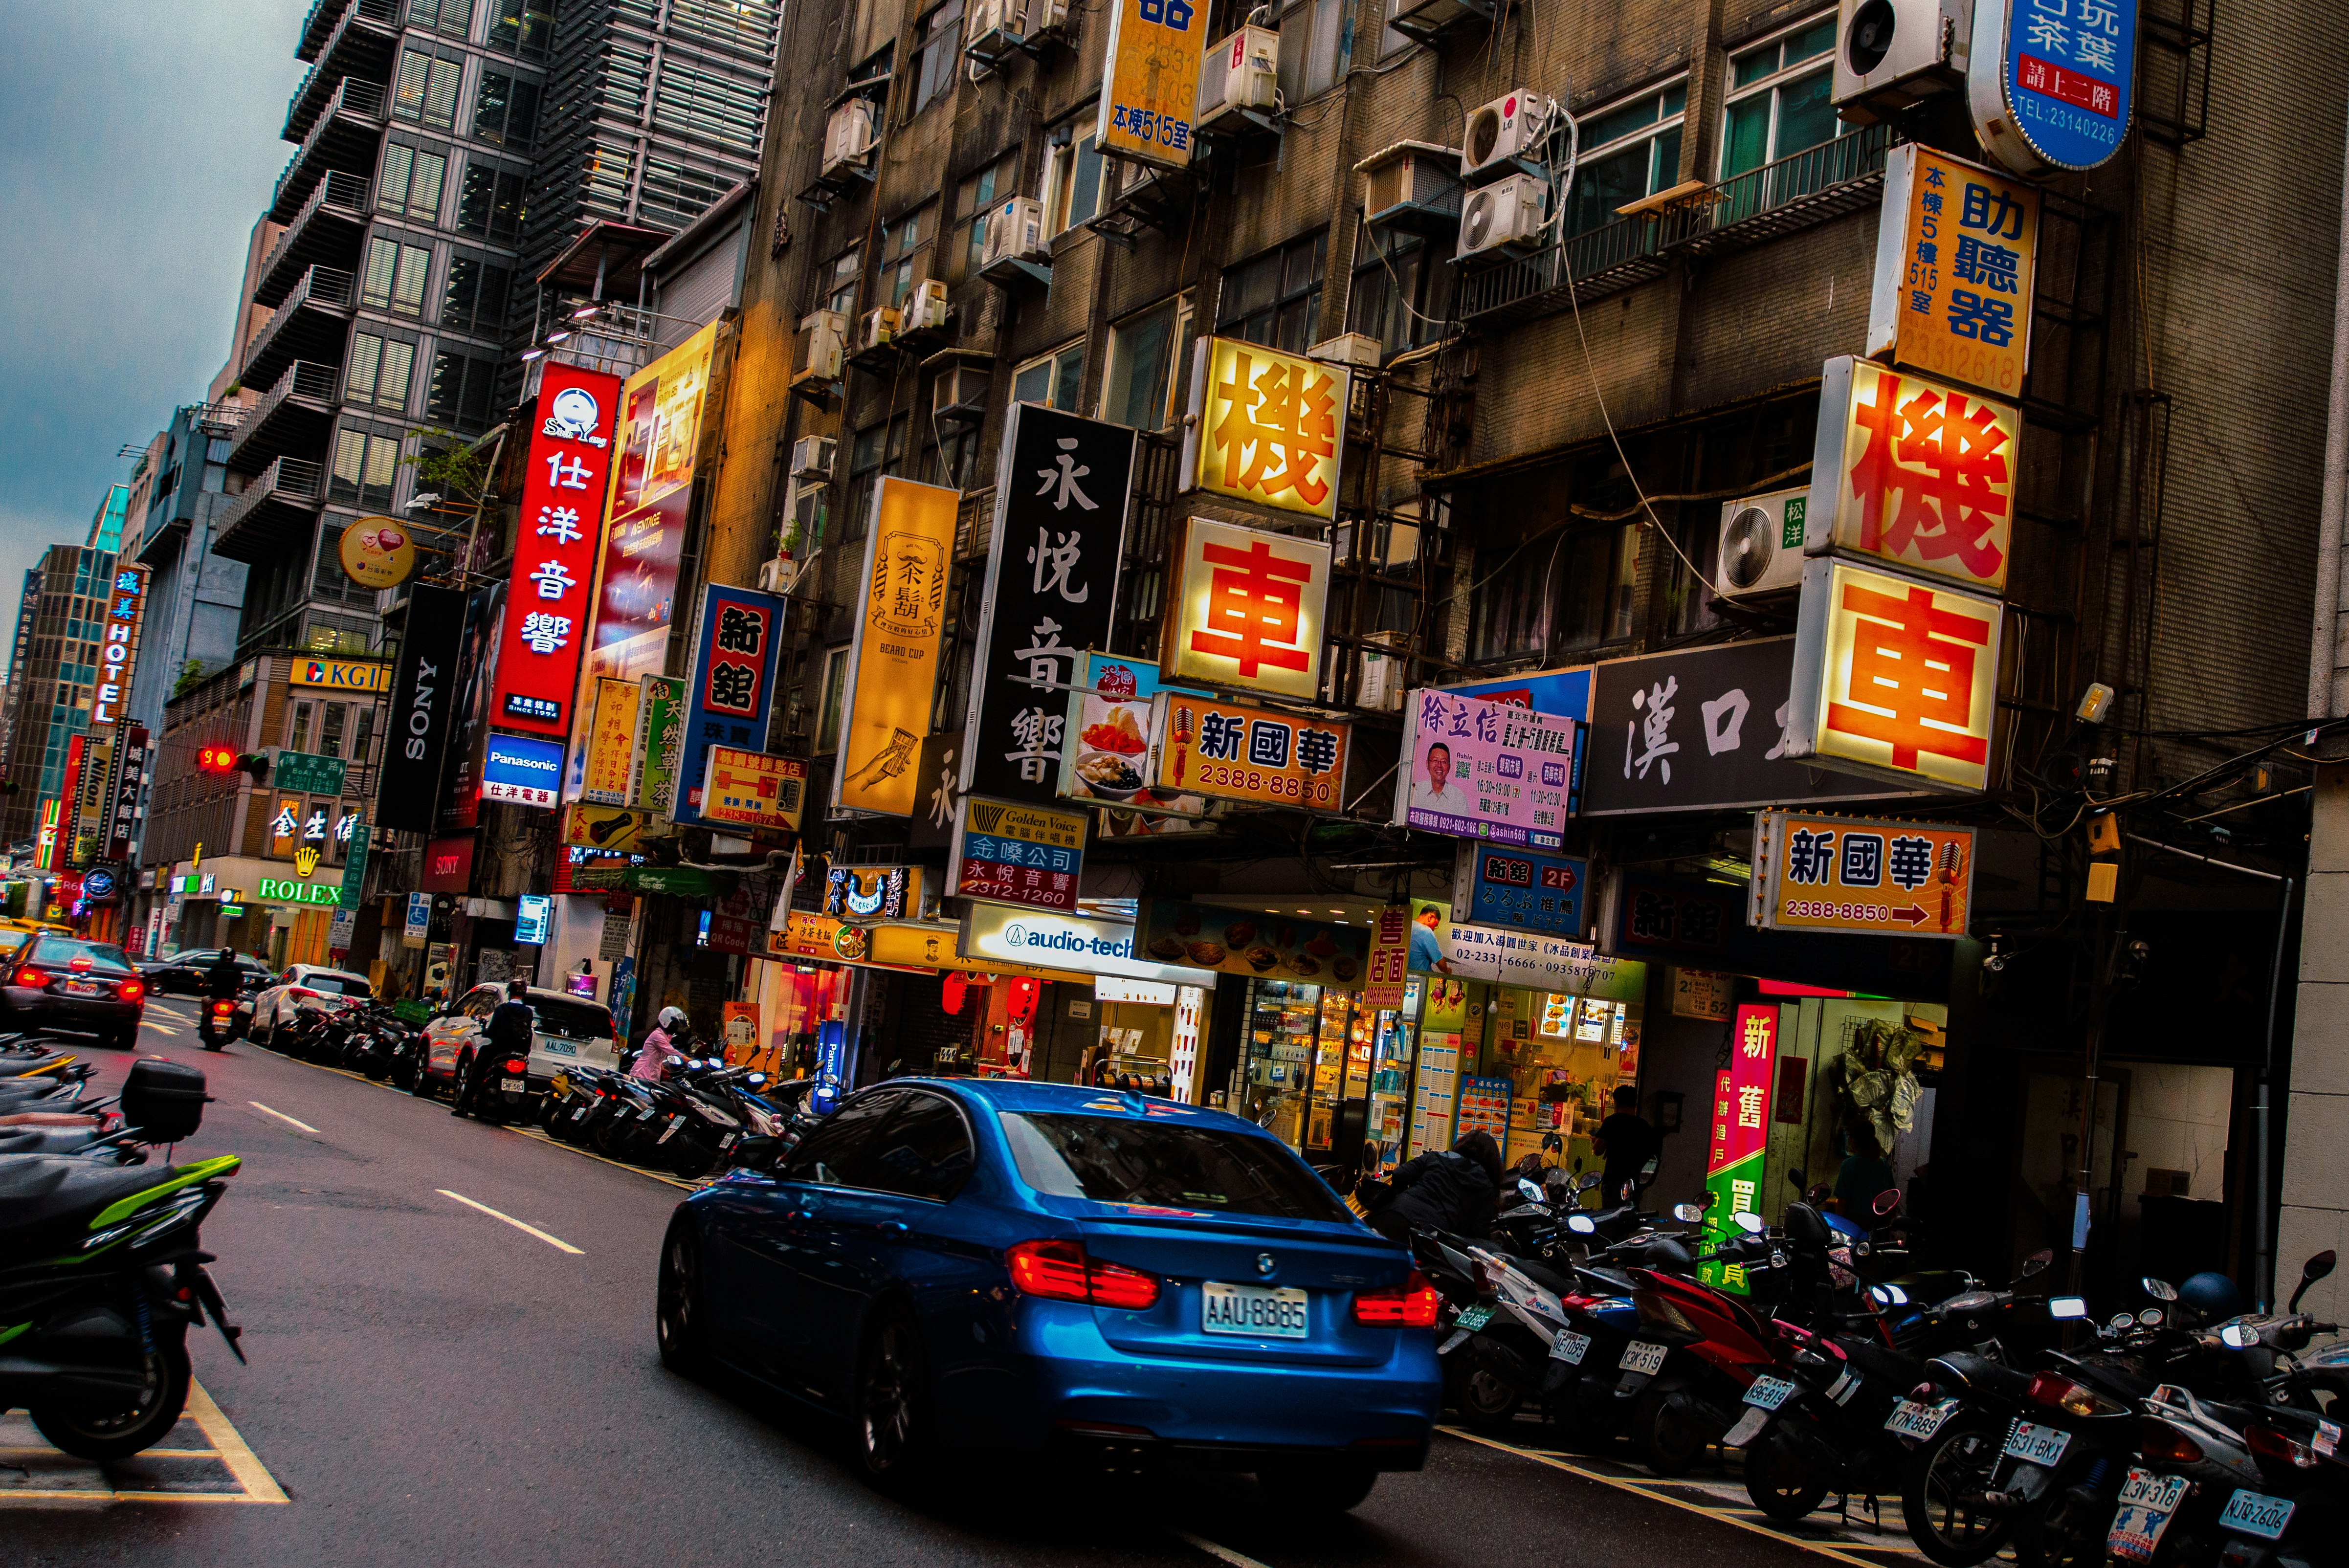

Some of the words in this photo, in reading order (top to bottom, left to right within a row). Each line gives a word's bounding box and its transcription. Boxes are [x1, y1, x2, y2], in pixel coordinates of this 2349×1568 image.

[2027, 62, 2112, 113] 請上二階
[1112, 102, 1190, 151] 本棟515室
[1503, 120, 1512, 131] LG
[2017, 94, 2115, 145] TEL:23140226
[1909, 166, 1946, 316] 本棟5樓515室
[1947, 182, 2024, 348] 助聽器
[631, 511, 661, 537] AVENTAGE
[1191, 351, 1336, 679] 機車
[1785, 502, 1803, 545] 松洋
[521, 450, 593, 655] 仕洋音響
[1827, 371, 2010, 771] 機車
[1004, 437, 1099, 784] 永悅音響
[880, 643, 905, 657] BEARD
[909, 648, 924, 660] CUP
[94, 624, 130, 722] HOTEL
[331, 664, 377, 687] KGI
[405, 657, 437, 760] SONY
[509, 706, 532, 714] SINCE
[534, 708, 556, 718] 1994
[1421, 694, 1500, 743] 徐立信
[1200, 711, 1339, 775] 新國華
[1456, 752, 1473, 760] Ashin
[286, 754, 339, 772] 博愛路
[292, 768, 312, 776] BoAi
[490, 751, 557, 772] Panasonic
[85, 756, 108, 807] Nikon
[114, 747, 144, 839] 城美大飯店
[490, 783, 549, 803] 仕洋電器
[1198, 764, 1330, 802] 2388-8850
[270, 807, 359, 842] 金生儀
[571, 808, 588, 842] 天華
[720, 808, 776, 825] 2382-1678
[1006, 811, 1045, 827] Golden
[1049, 817, 1077, 832] Voice
[1439, 817, 1477, 835] 0921-602-186
[1005, 825, 1075, 846] 電腦伴唱機
[1489, 824, 1526, 842] @ashin666
[349, 834, 365, 882] 漢口街一段
[435, 856, 458, 875] SONY
[972, 837, 1070, 871] 金嗓公司
[1789, 827, 1933, 891] 新國華
[968, 861, 1069, 891] 永悅音響
[1548, 869, 1570, 885] 2F
[260, 878, 342, 905] ROLEX
[967, 880, 1064, 905] 2312-1260
[1482, 886, 1533, 910] るるぶ
[1540, 896, 1574, 915] 推薦
[1498, 910, 1525, 924] 二階
[1532, 913, 1565, 929] どうぞ
[1786, 899, 1888, 922] 2388-8850
[711, 933, 722, 943] QR
[725, 935, 745, 948] Code
[1378, 909, 1404, 945] 售
[1369, 947, 1406, 983] 店面
[545, 1042, 577, 1055] AAL-7090
[1713, 1076, 1731, 1164] 代辦過戶
[1206, 1296, 1305, 1329] AAU-8885
[1552, 1336, 1585, 1358] NAE-1095
[1622, 1349, 1662, 1369] K3K-519
[1744, 1384, 1786, 1405] N96-819
[1886, 1408, 1938, 1435] K7N-889
[2010, 1433, 2062, 1461] 631-BKX
[2121, 1479, 2178, 1507] L3V-318
[2225, 1500, 2286, 1530] NJQ-2606
